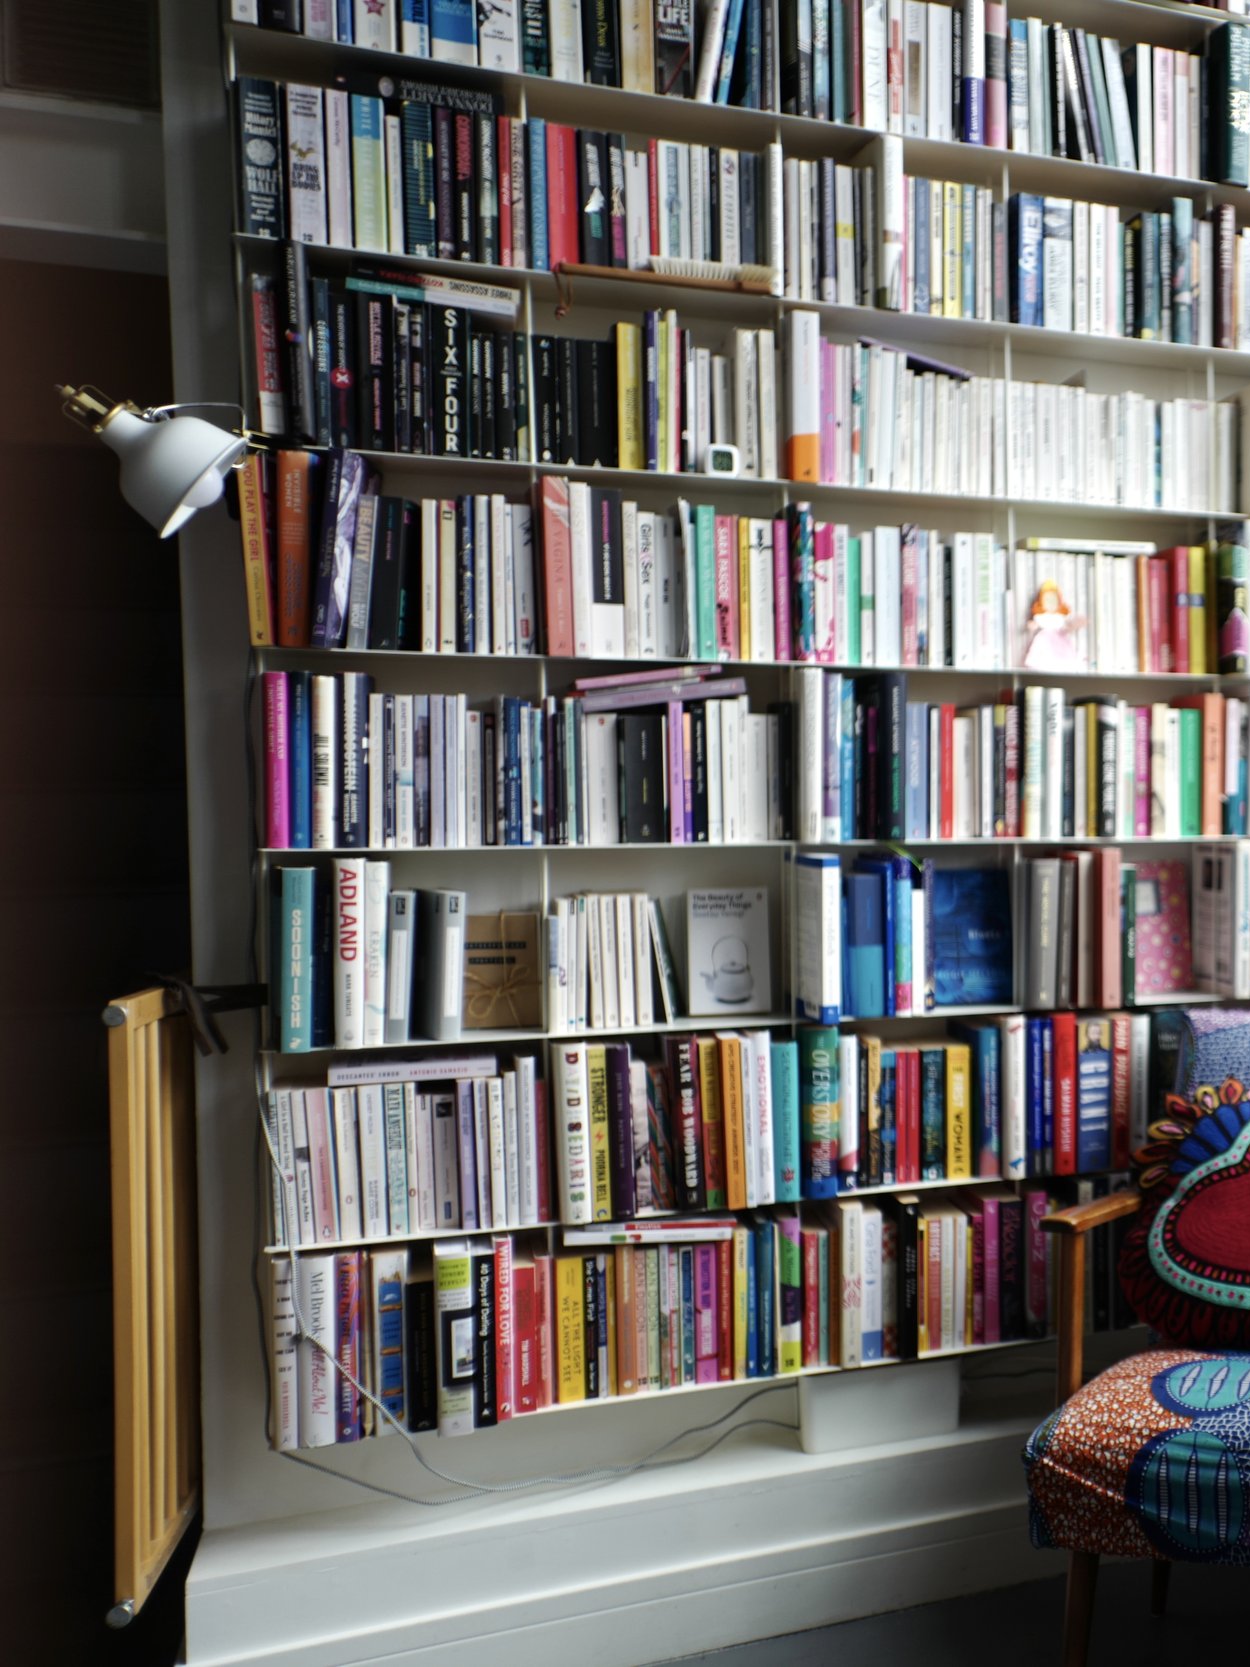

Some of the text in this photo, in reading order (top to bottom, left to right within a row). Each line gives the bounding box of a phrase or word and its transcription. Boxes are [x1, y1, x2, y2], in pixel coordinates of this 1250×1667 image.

[657, 6, 690, 26] LIFE
[1231, 26, 1244, 82] PULLMAN
[359, 97, 373, 129] WHITE
[246, 164, 278, 183] WOLF
[247, 178, 278, 195] HALL
[1019, 208, 1042, 272] Ellroy
[317, 320, 328, 372] CONFESSIONS
[444, 307, 460, 452] SIX FOUR
[241, 465, 262, 562] YOU PLAY THE GIRL
[284, 473, 293, 509] WOMEN
[293, 469, 303, 514] INVISIBLE
[355, 508, 371, 562] BEAUTY
[640, 524, 654, 584] Girls Sex
[717, 526, 729, 556] SARA
[717, 559, 730, 602] PASCOE
[313, 735, 328, 787] JILL SOLOWAY
[401, 702, 409, 768] JEANETTE WINTERSON
[338, 868, 357, 962] ADLAND
[692, 892, 744, 904] The Beauty of
[692, 901, 752, 911] Everyday Things
[370, 930, 380, 979] KRAKEN
[731, 1094, 741, 1127] STRATEGY
[757, 1055, 769, 1137] EMOTIONAL
[811, 1049, 831, 1139] OVERSTORY
[1080, 1060, 1111, 1132] GRANT
[1114, 1053, 1128, 1116] PREJUDICE
[387, 1089, 402, 1151] MAYA ANGELOU
[591, 1067, 608, 1204] STRONGER POORNA BELL
[679, 1043, 698, 1188] FEAR BOB WOODWARD
[953, 1073, 965, 1161] FIRST WOMAN
[1060, 1077, 1072, 1153] SALMAN RUSHDIE
[567, 1122, 586, 1204] SEDARIS
[819, 1139, 832, 1178] RICHARD
[585, 1260, 595, 1275] She
[864, 1222, 878, 1275] Gina Ford
[478, 1263, 491, 1337] 40 Days of Dating
[499, 1245, 511, 1346] WIRED FOR LOVE
[587, 1303, 597, 1322] First
[636, 1256, 647, 1333] JOAN DIDION
[648, 1254, 659, 1332] JOAN DIDION
[311, 1271, 331, 1416] Mel Brooks All About Me!
[521, 1339, 530, 1386] TIM MARSHALL
[562, 1296, 573, 1383] WE CANNOT SEE
[572, 1301, 582, 1375] ALL THE LIGHT
[342, 1384, 352, 1413] NAKATE
